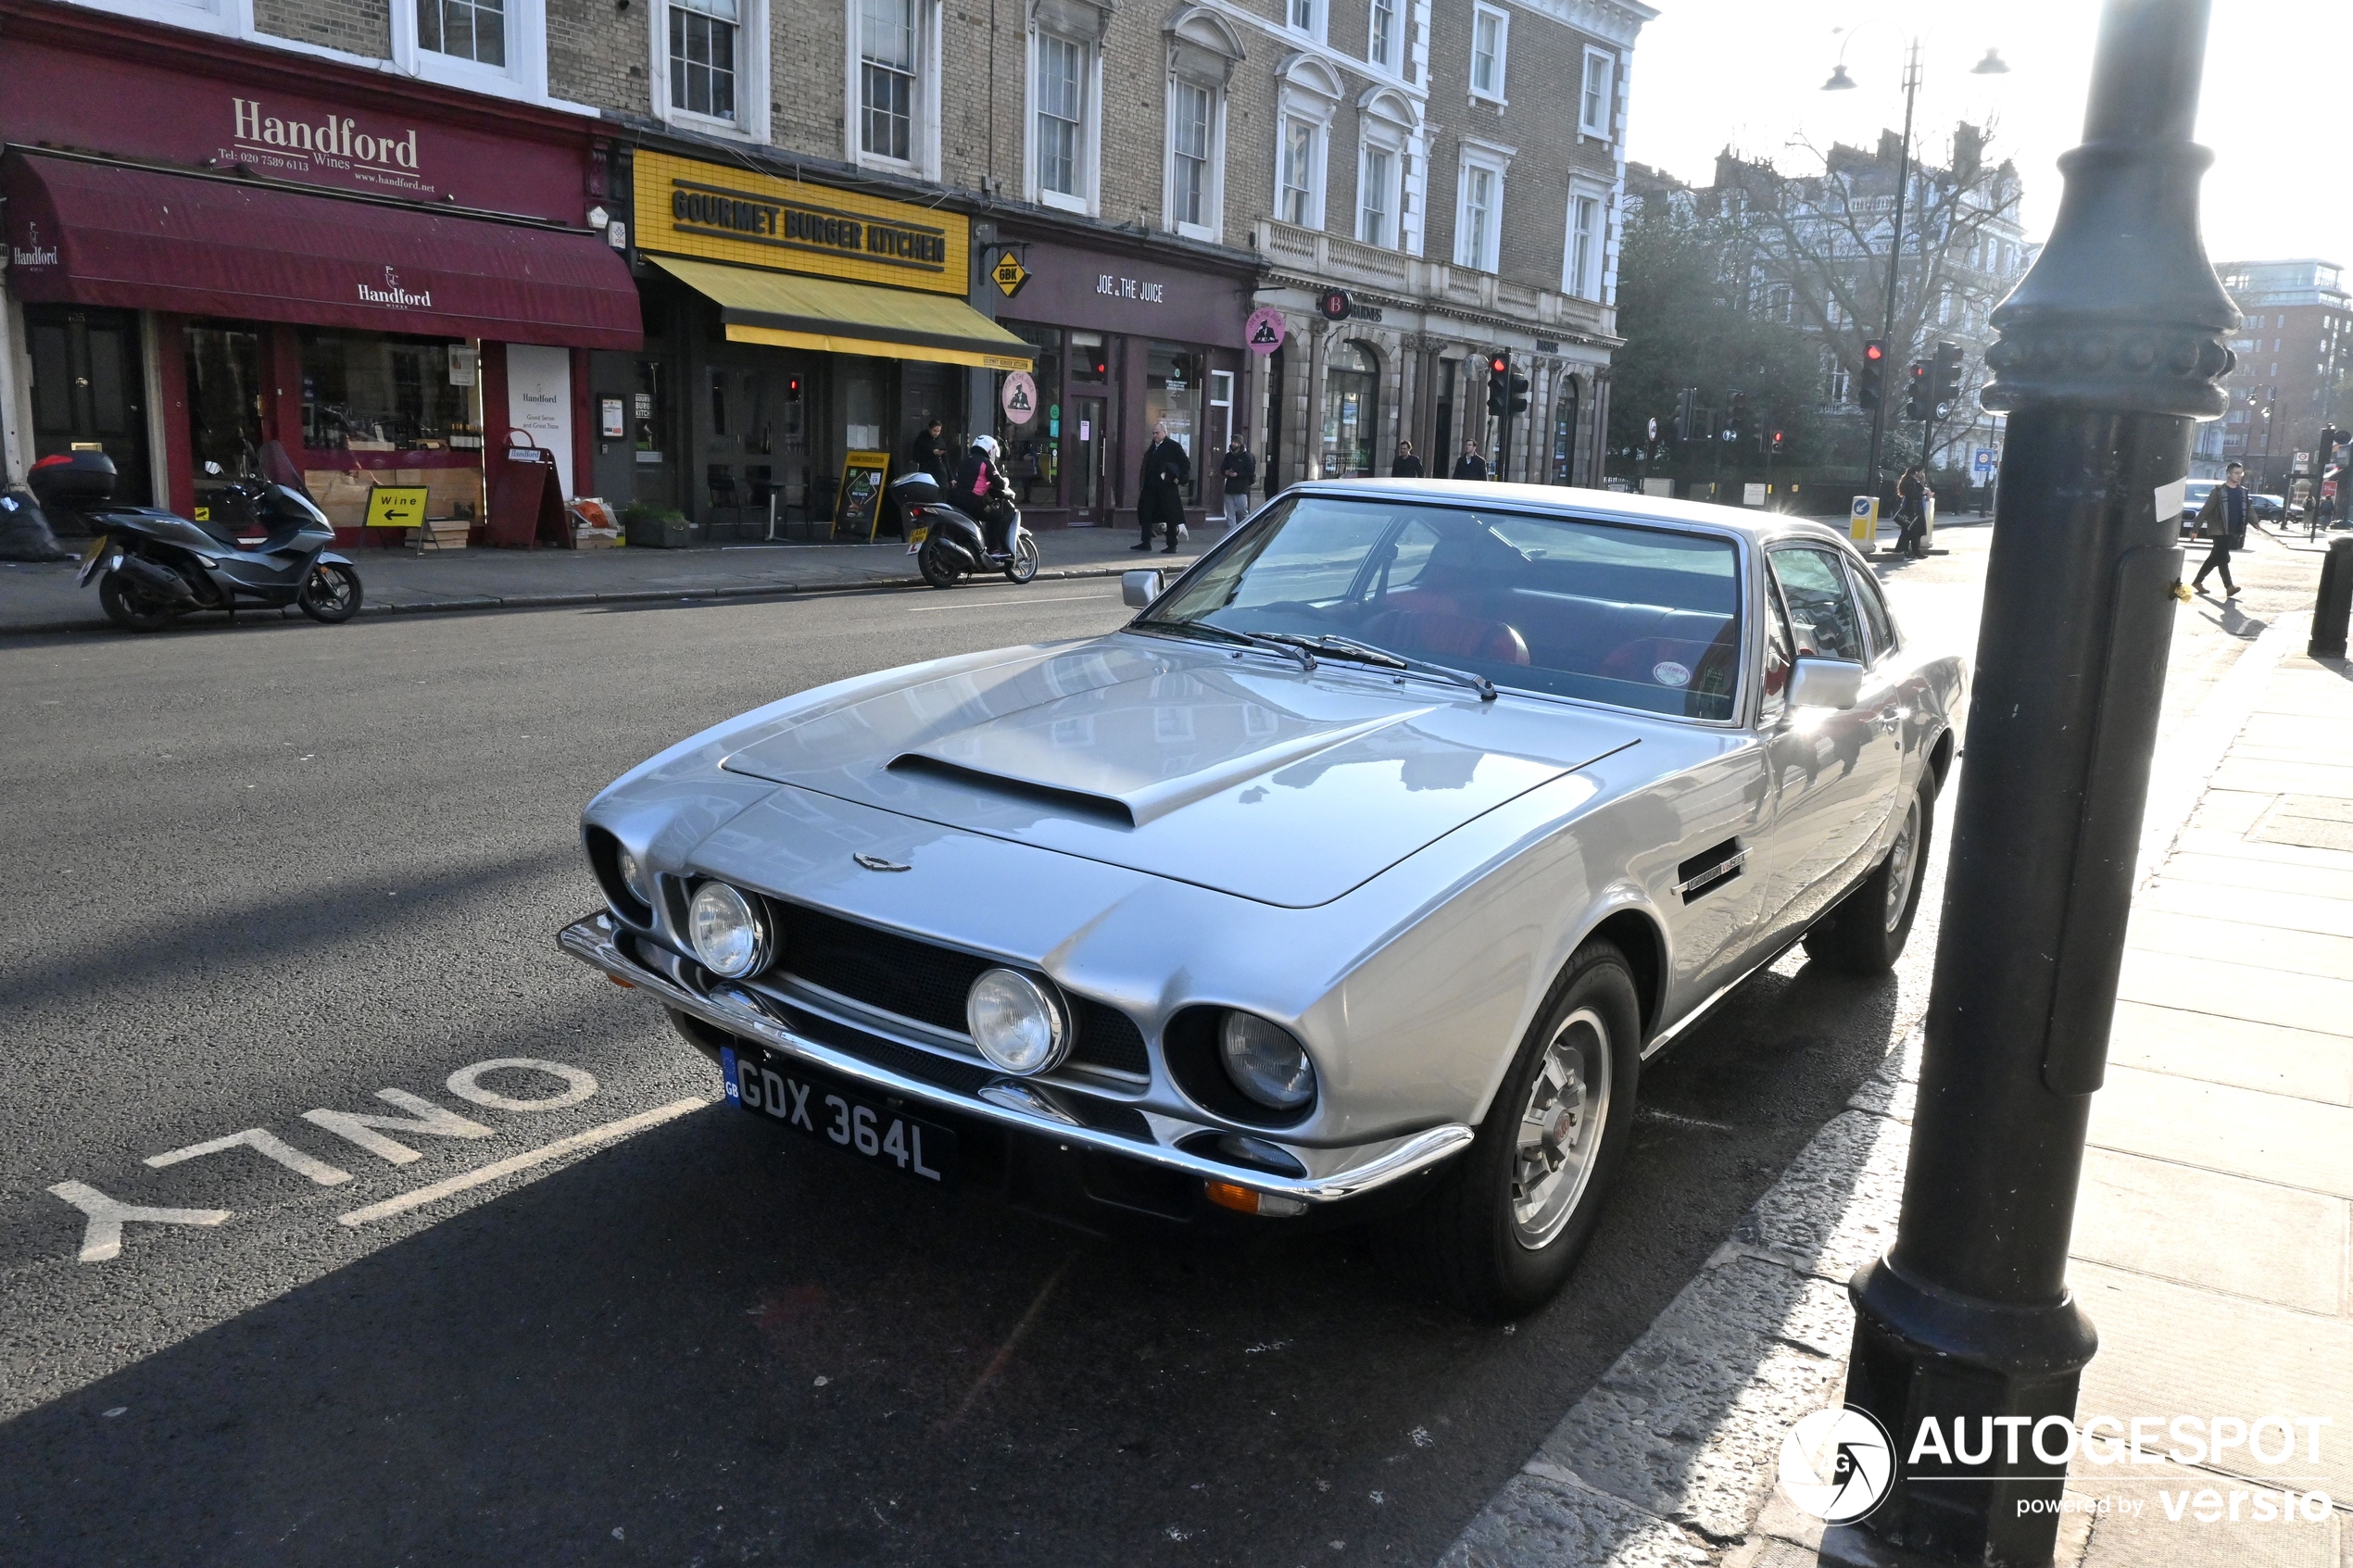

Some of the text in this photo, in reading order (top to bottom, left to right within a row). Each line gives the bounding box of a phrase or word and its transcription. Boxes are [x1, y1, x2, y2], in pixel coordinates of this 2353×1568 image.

[232, 97, 419, 169] Handford
[218, 148, 308, 171] Tel: 020 7589 6113
[312, 152, 350, 169] Wines
[355, 172, 435, 193] www.handford.net
[673, 190, 945, 263] GOURMET BURGER KITCHEN
[14, 245, 57, 265] Handford
[1000, 268, 1017, 281] GBK
[358, 283, 432, 307] Handford
[1097, 274, 1113, 295] JOE
[1120, 278, 1136, 298] THE
[1139, 282, 1163, 303] JUICE
[1330, 296, 1340, 312] B
[1270, 314, 1283, 327] JUICE
[522, 393, 557, 404] Handford
[510, 449, 539, 458] Handford
[381, 496, 416, 506] Wine
[725, 1082, 739, 1098] GB
[737, 1060, 941, 1182] GDX 364L
[46, 1058, 598, 1262] ONLY
